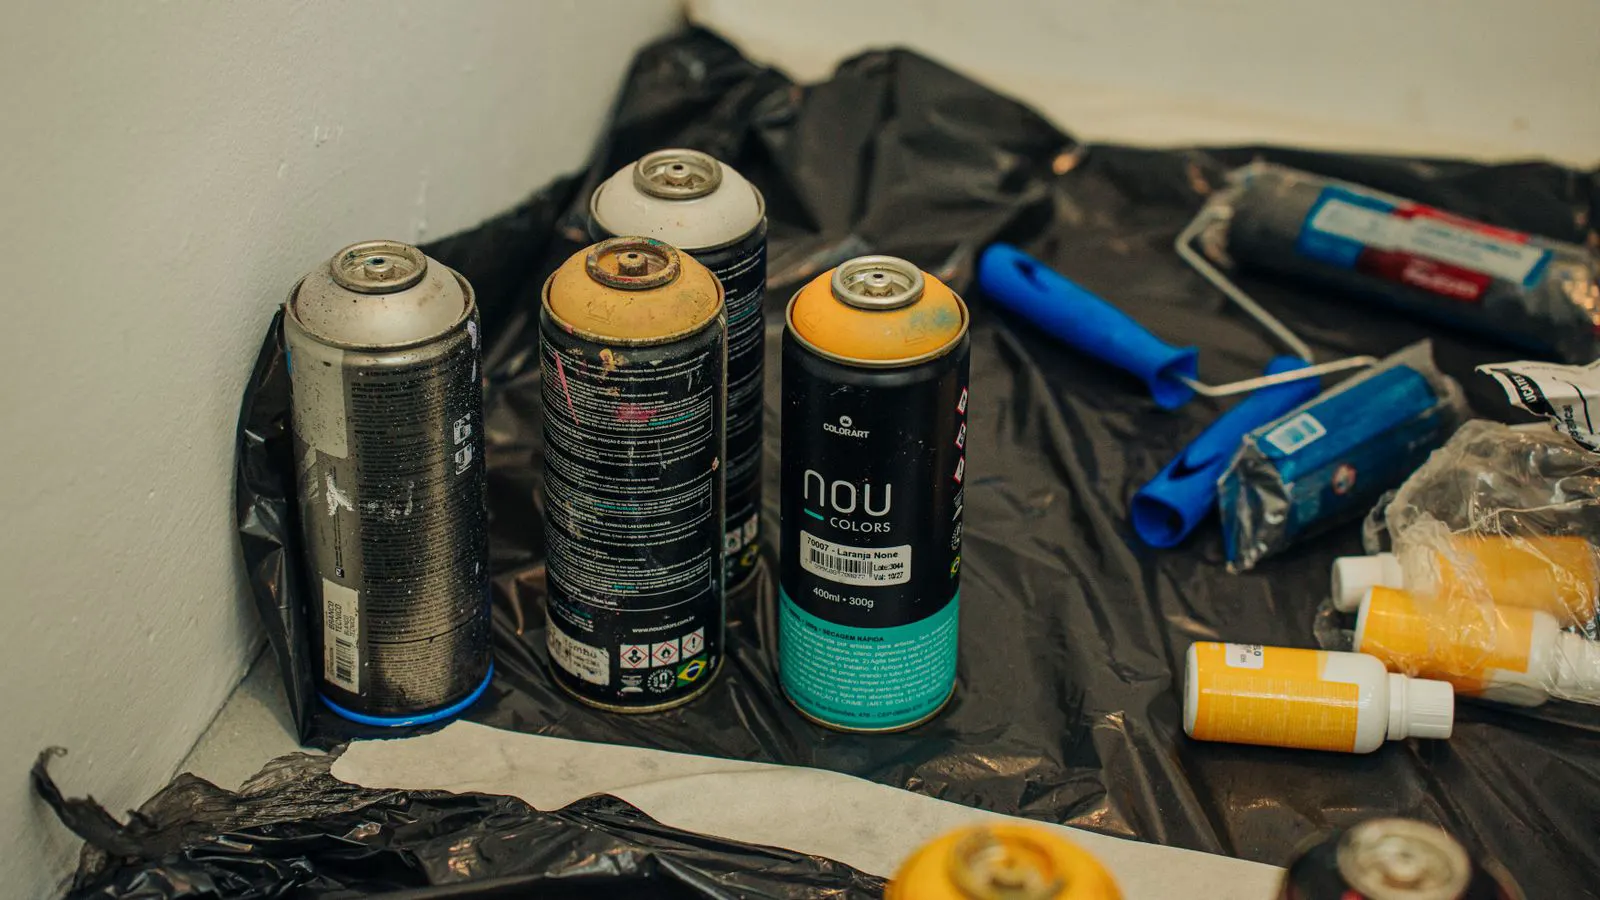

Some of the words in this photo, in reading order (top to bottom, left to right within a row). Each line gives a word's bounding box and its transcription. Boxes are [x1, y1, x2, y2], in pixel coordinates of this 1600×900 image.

[823, 422, 870, 438] COLORART
[830, 516, 890, 532] COLORS
[806, 536, 829, 552] 70007
[837, 548, 871, 560] Laranja
[812, 587, 840, 602] 400ml
[849, 596, 874, 609] 300g
